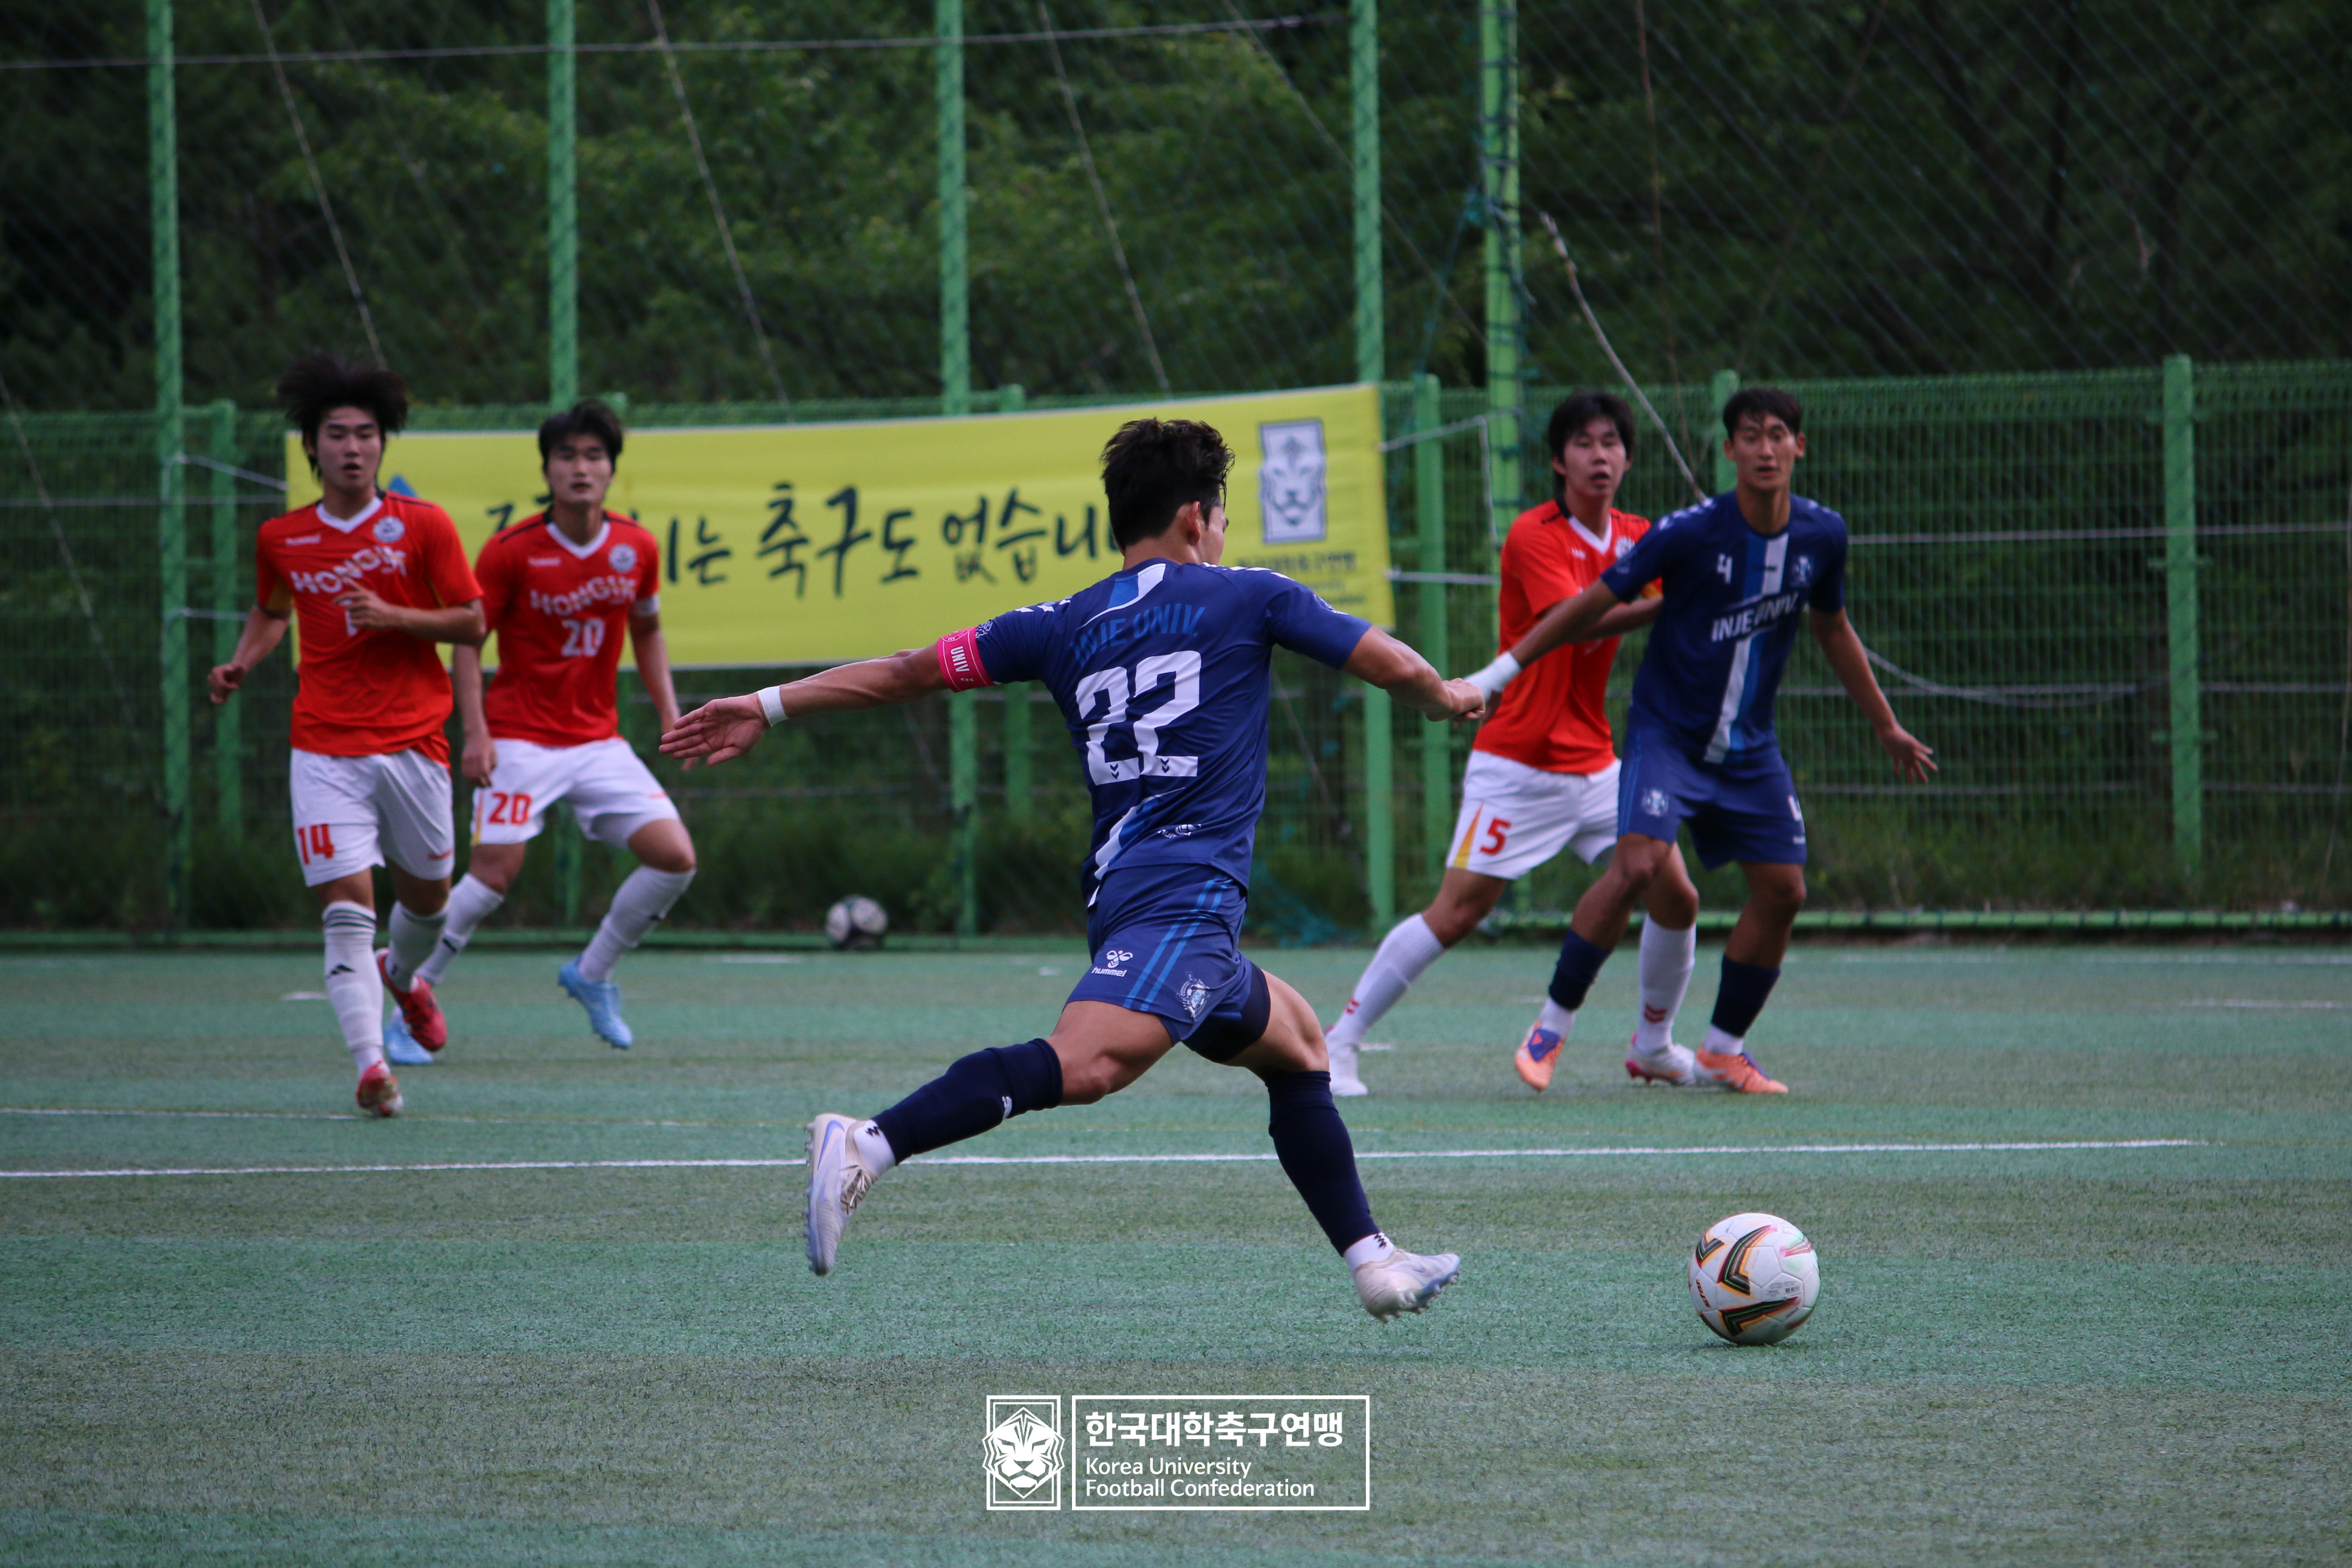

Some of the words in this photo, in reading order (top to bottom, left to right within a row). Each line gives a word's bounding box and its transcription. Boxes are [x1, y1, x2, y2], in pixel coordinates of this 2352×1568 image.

[756, 482, 919, 598] 축구도
[943, 486, 1120, 585] 없습니
[1716, 553, 1733, 584] 4
[561, 617, 605, 657] 20
[1711, 609, 1754, 642] INJE
[950, 646, 970, 672] UNIV
[1075, 650, 1201, 786] 22
[488, 792, 532, 825] 20
[298, 824, 335, 866] 14
[1479, 817, 1512, 855] 5
[1091, 967, 1127, 977] hummel
